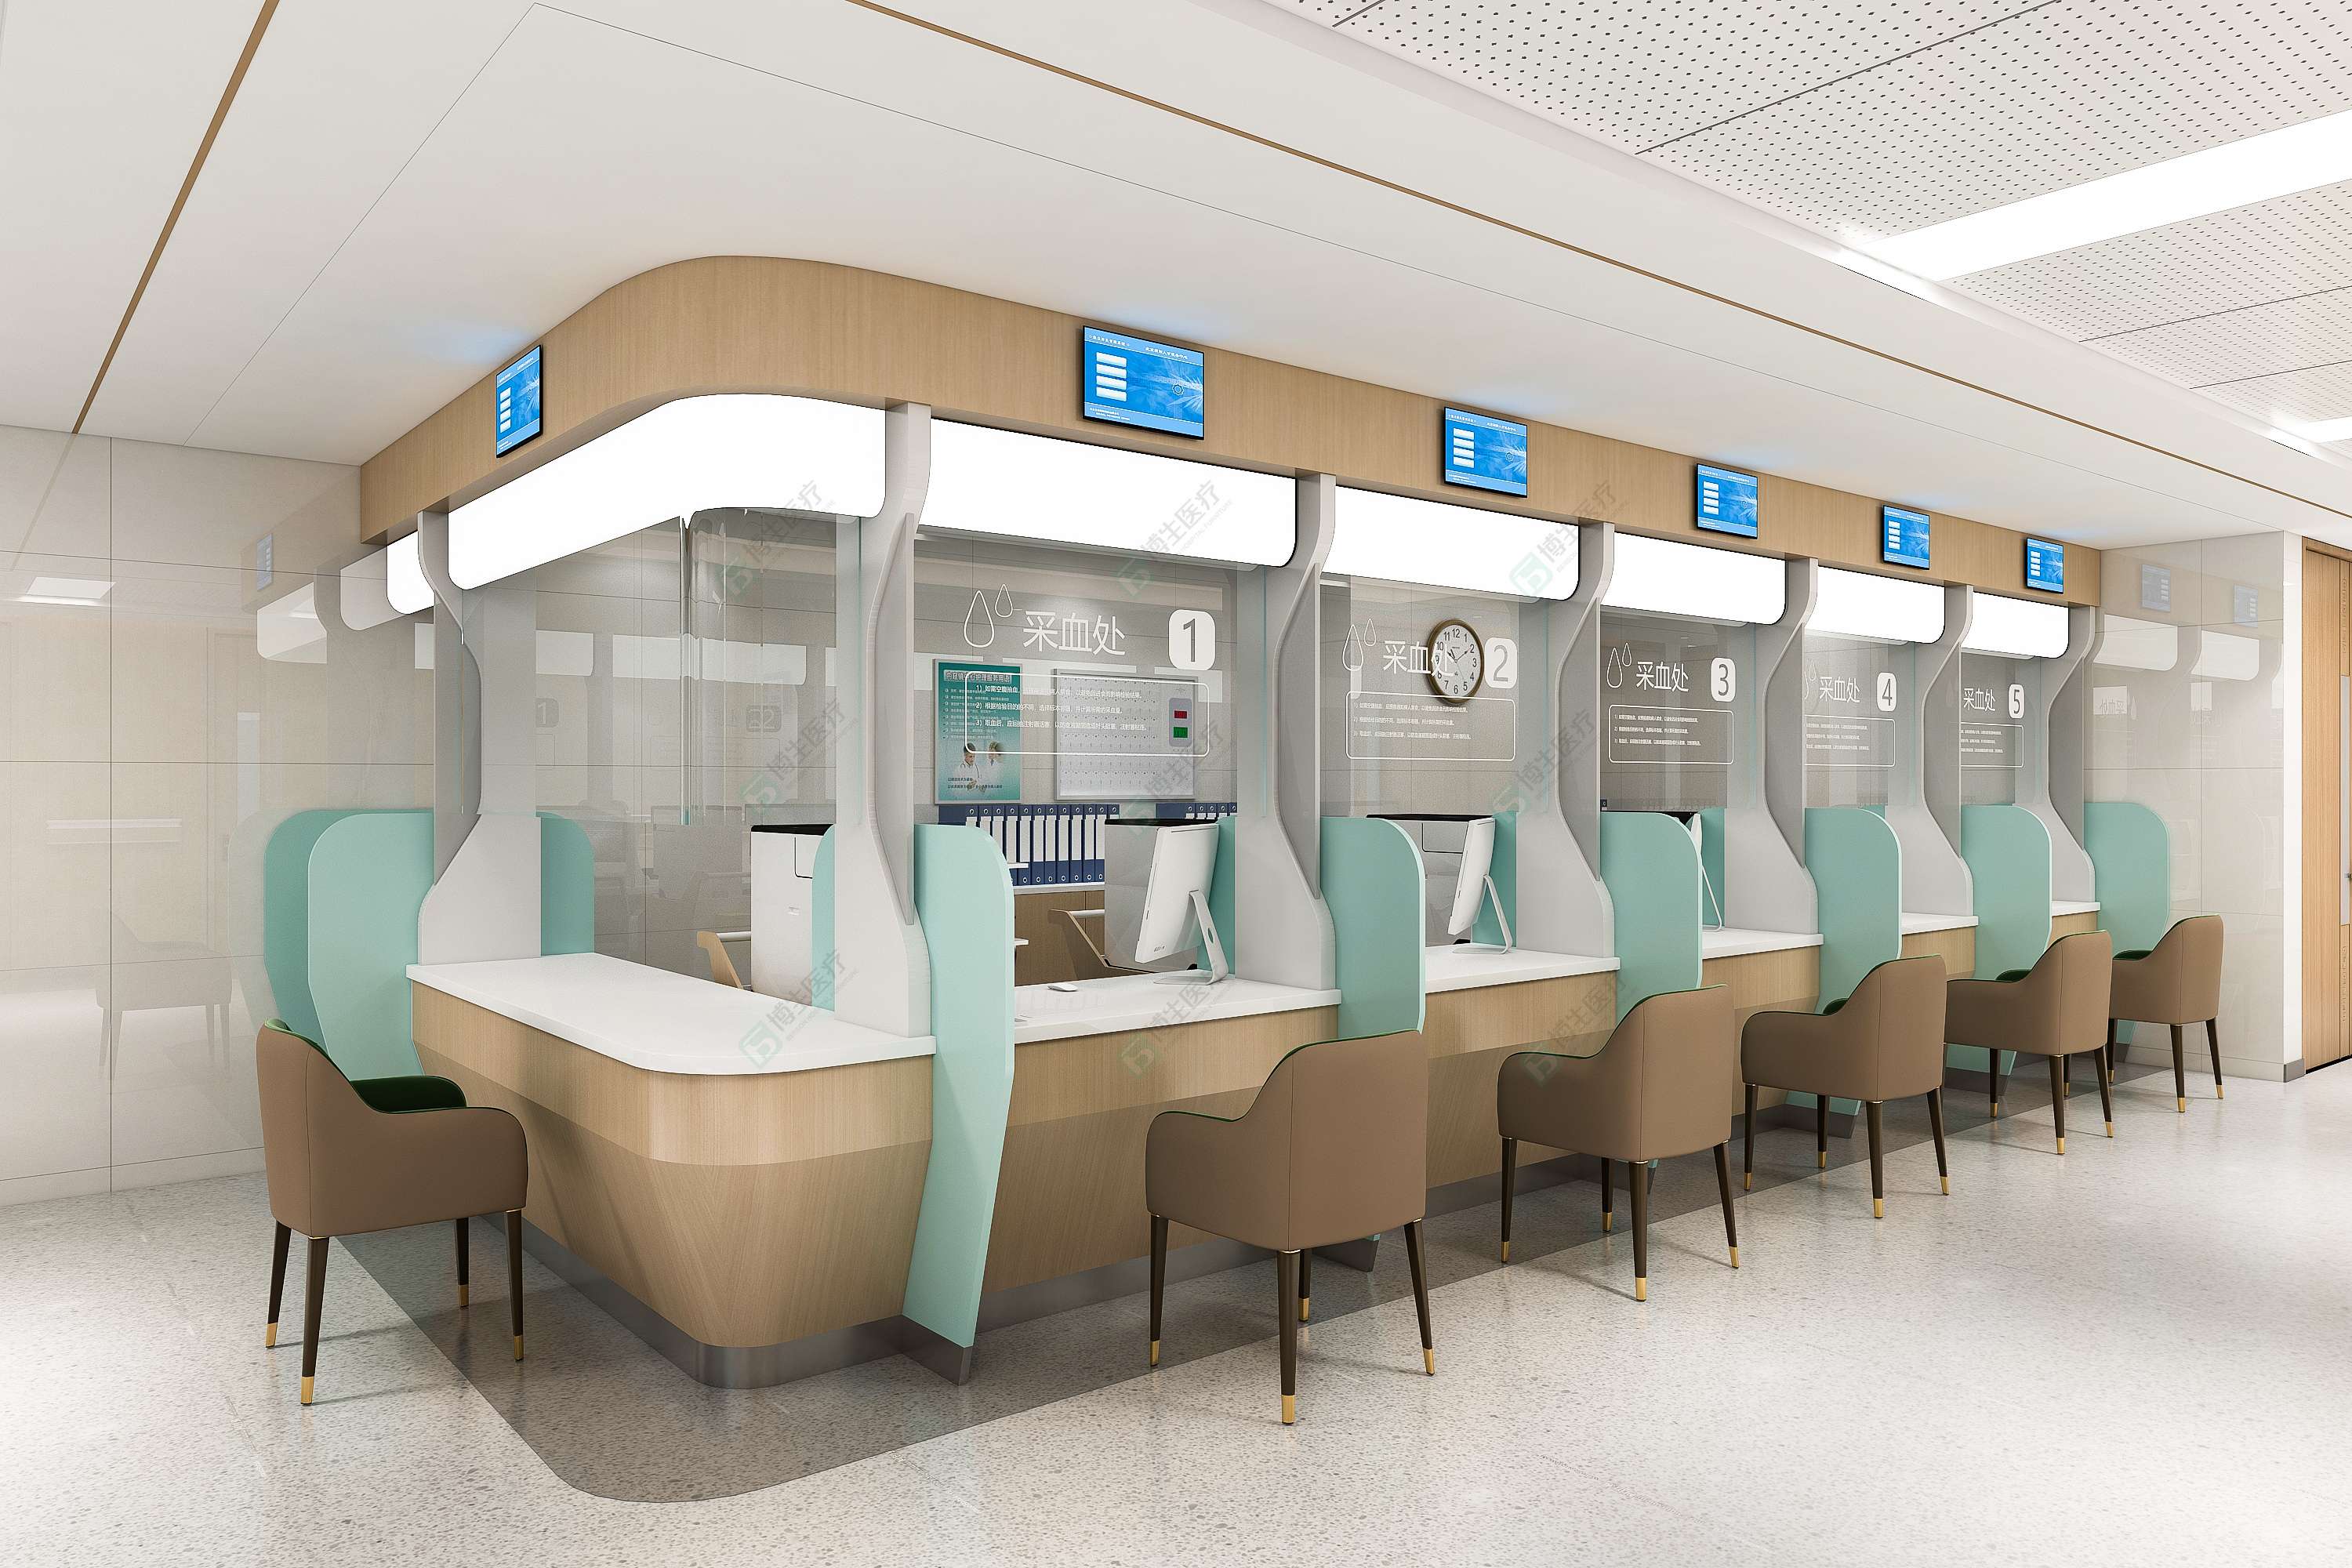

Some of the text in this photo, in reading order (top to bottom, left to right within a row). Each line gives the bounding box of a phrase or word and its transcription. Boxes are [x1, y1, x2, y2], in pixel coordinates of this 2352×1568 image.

[1022, 611, 1126, 655] 采血处
[1183, 618, 1196, 662] 1
[1443, 631, 1450, 641] 11
[1452, 628, 1461, 638] 12
[1464, 633, 1468, 643] 1
[1436, 641, 1444, 651] 10
[1469, 644, 1475, 654] 2
[1383, 640, 1455, 677] 采血处
[1472, 658, 1477, 667] 3
[1493, 644, 1508, 681] 2
[1444, 680, 1449, 690] 7
[1470, 672, 1475, 681] 4
[1636, 661, 1690, 691] 采血处
[1718, 663, 1730, 695] 3
[1454, 684, 1458, 695] 6
[1463, 681, 1468, 691] 5
[1819, 676, 1860, 703] 采血处
[1882, 678, 1893, 706] 4
[1963, 687, 1996, 712] 采血处
[2013, 689, 2020, 714] 5
